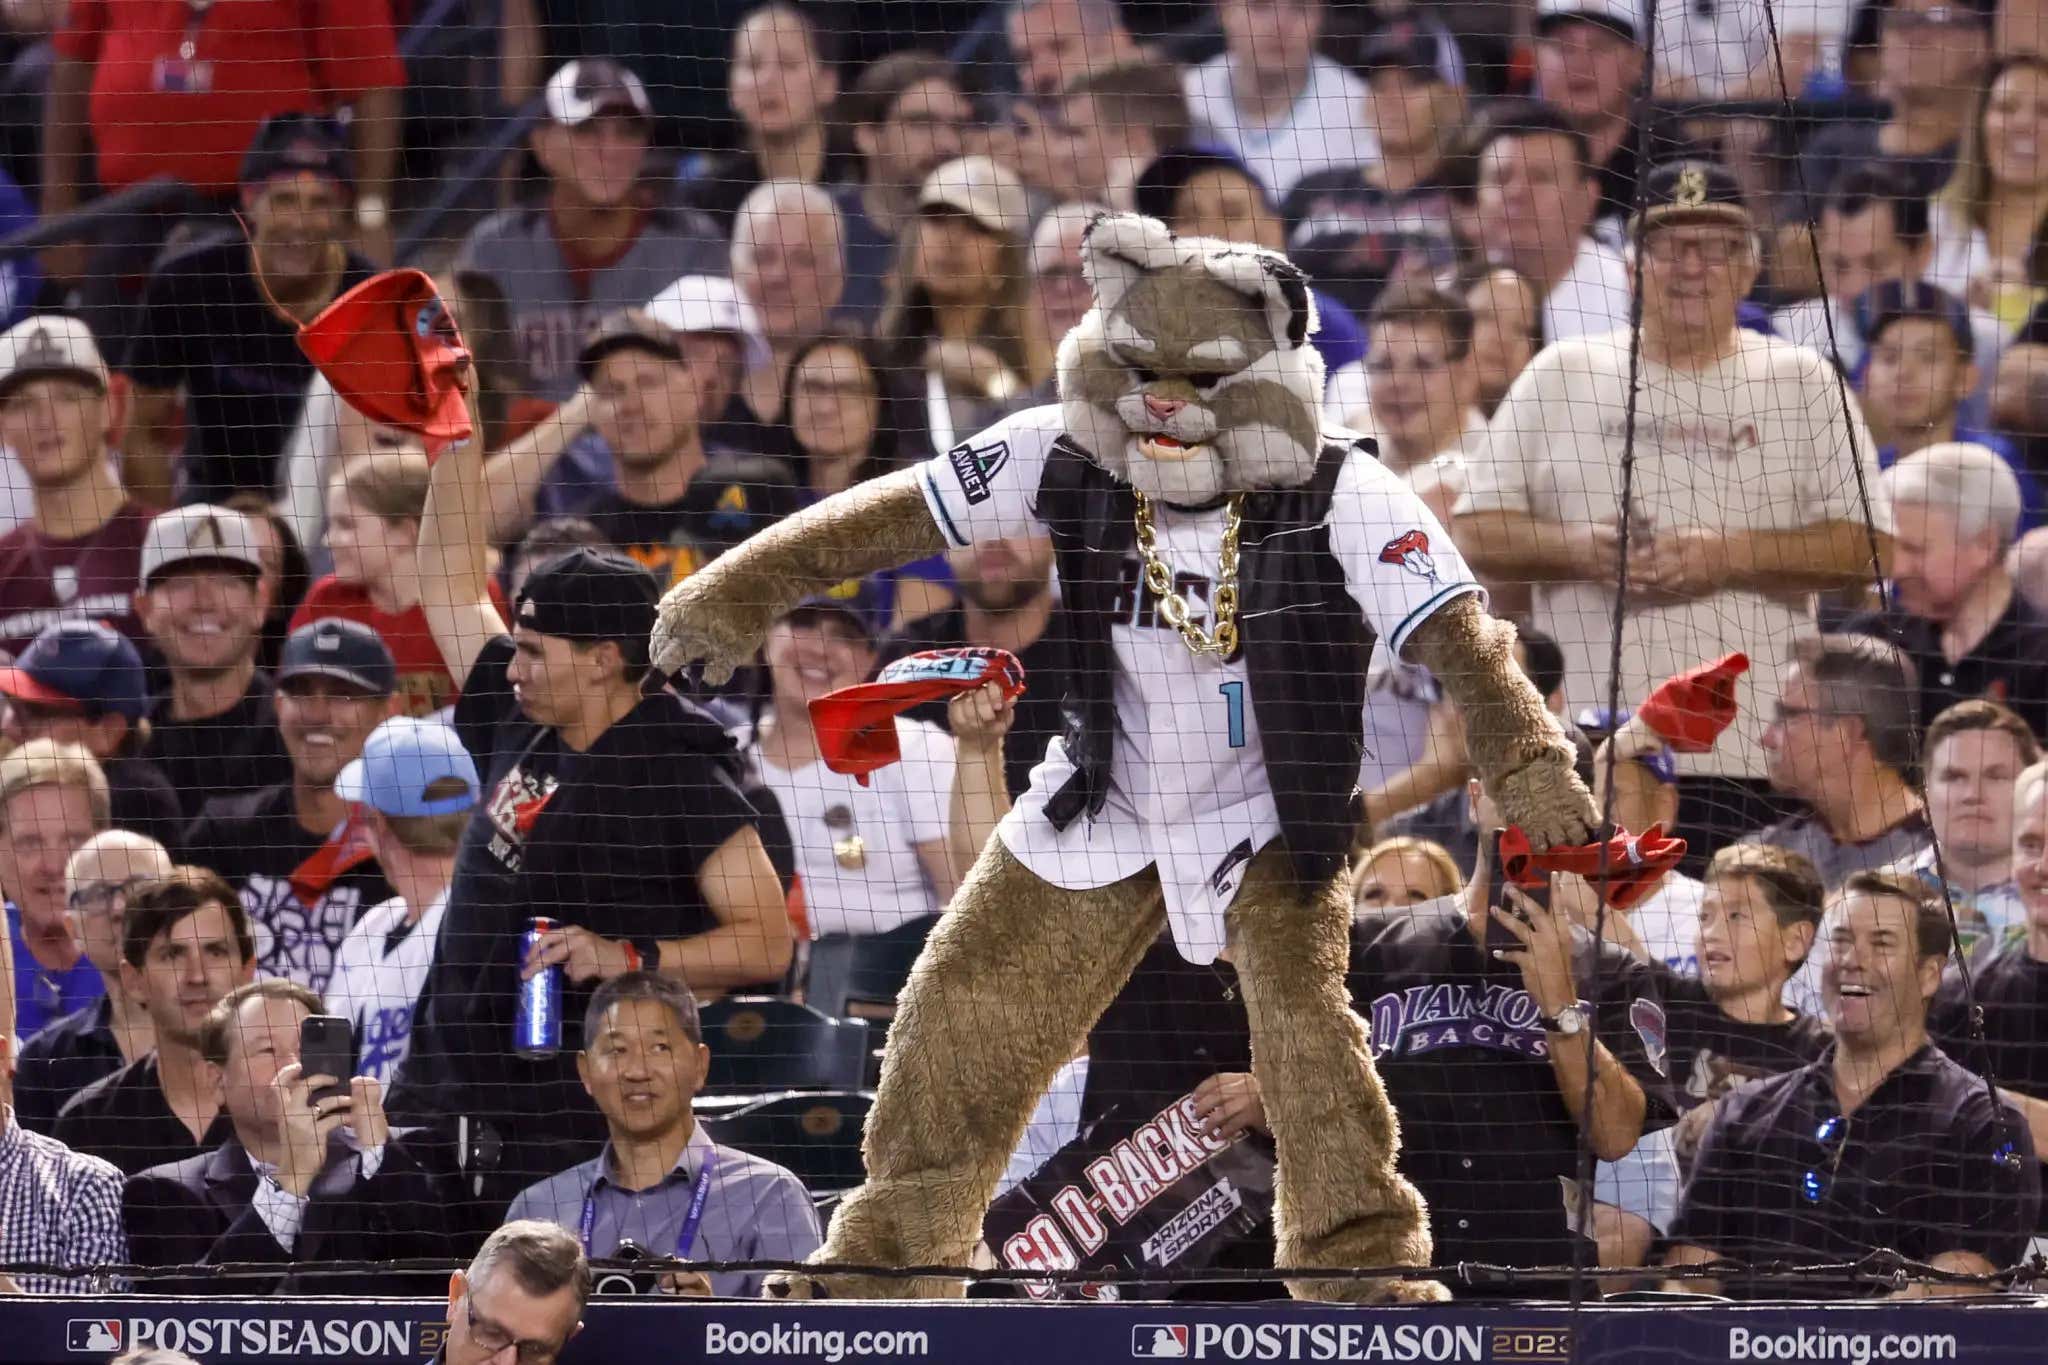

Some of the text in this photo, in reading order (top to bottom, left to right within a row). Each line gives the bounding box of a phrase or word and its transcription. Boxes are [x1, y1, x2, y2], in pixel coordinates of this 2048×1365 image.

[952, 450, 986, 497] AVNET
[1219, 681, 1246, 748] 1
[1411, 1024, 1548, 1057] BACKS
[1149, 1186, 1226, 1251] ARIZONA
[1164, 1197, 1235, 1262] SPORTS
[1003, 1213, 1079, 1299] GO
[129, 1318, 412, 1355] POSTSEASON
[706, 1322, 928, 1363] Booking.com
[1194, 1323, 1485, 1361] POSTSEASON
[1729, 1326, 1956, 1365] Booking.com
